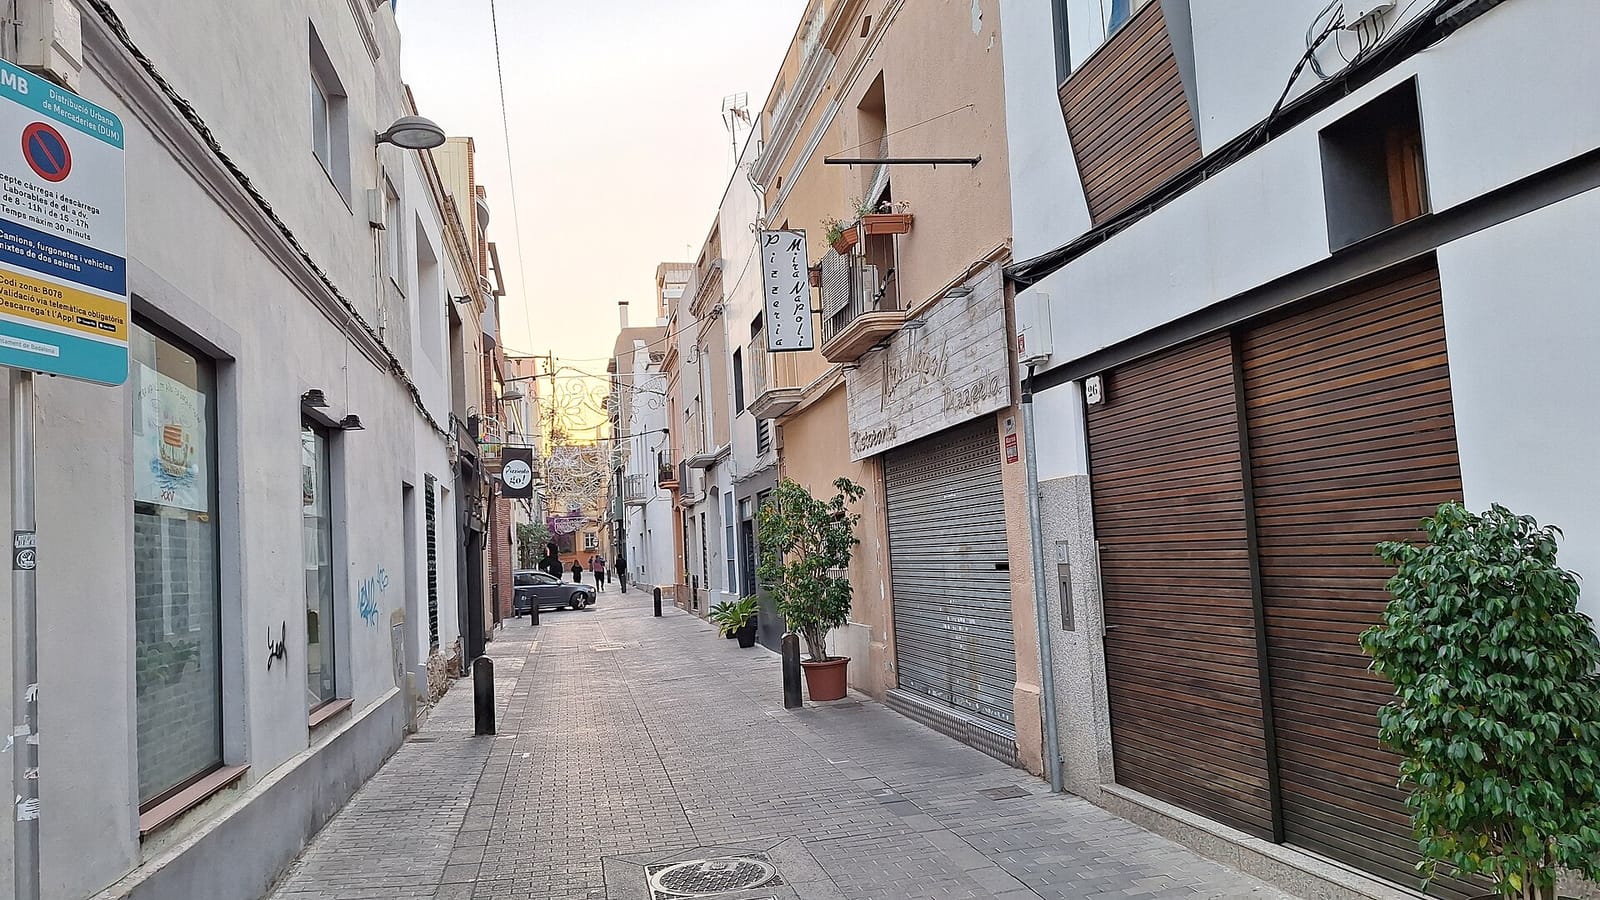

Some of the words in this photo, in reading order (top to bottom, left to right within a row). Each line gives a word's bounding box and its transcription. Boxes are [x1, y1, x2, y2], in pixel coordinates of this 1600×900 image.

[42, 99, 52, 111] de
[53, 103, 97, 131] Mercaderies
[97, 122, 120, 141] (DUM)
[49, 88, 88, 115] Distribució
[89, 108, 114, 127] Urbana
[2, 193, 13, 203] de
[15, 197, 20, 206] 8
[28, 202, 42, 214] 11h
[44, 206, 47, 215] i
[49, 209, 58, 218] de
[60, 213, 69, 223] 15
[76, 218, 89, 229] 17h
[3, 183, 48, 205] Laborables
[50, 200, 59, 210] de
[72, 208, 77, 216] a
[78, 210, 89, 220] dv.
[24, 181, 54, 198] càrrega
[55, 191, 58, 200] i
[60, 193, 100, 215] descàrrega
[0, 203, 26, 219] Temps
[28, 214, 53, 229] màxim
[54, 222, 65, 232] 30
[66, 227, 91, 241] minuts
[26, 249, 36, 259] de
[37, 252, 52, 264] dos
[53, 258, 81, 272] seients
[37, 241, 79, 262] furgonetes
[84, 256, 114, 272] vehicles
[786, 238, 802, 278] Mira
[19, 281, 41, 294] zona:
[42, 286, 63, 299] B078
[764, 234, 783, 346] Pizzeria
[36, 296, 48, 306] via
[49, 300, 87, 316] telemàtica
[88, 310, 124, 325] obligatòria
[789, 281, 806, 347] Napoli
[1087, 383, 1099, 398] 26
